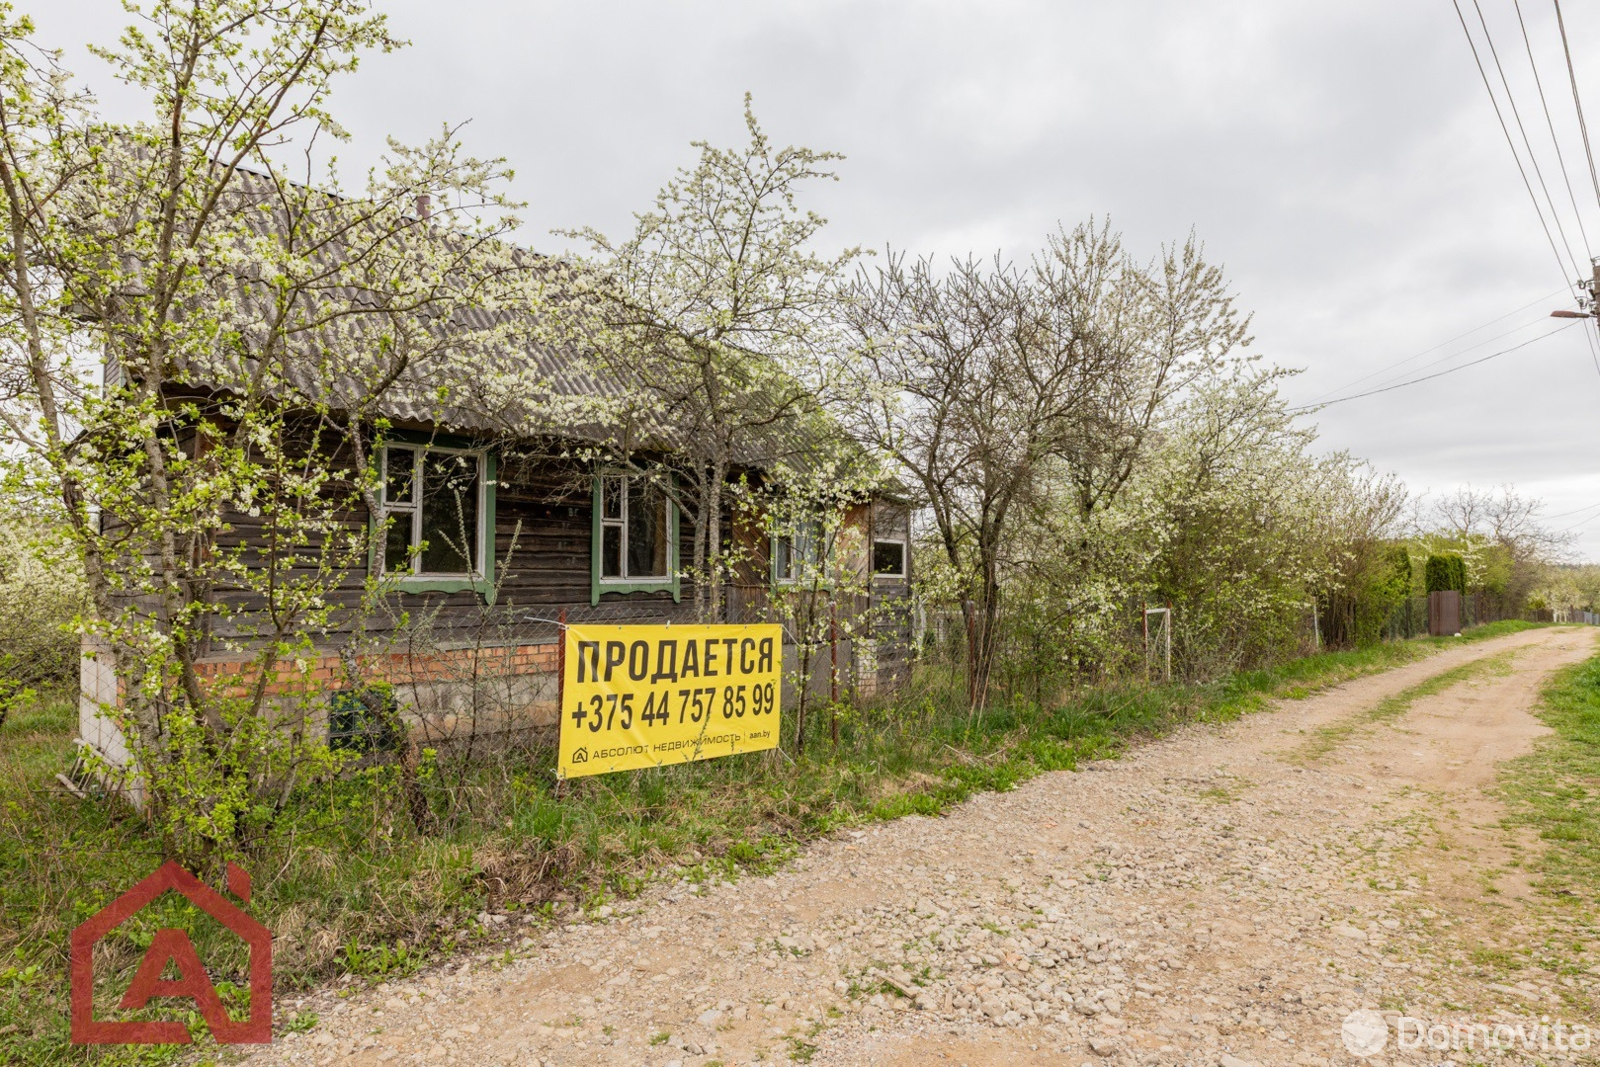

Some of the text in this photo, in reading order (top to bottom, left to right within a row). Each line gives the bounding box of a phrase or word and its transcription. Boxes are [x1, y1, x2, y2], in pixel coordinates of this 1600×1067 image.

[576, 637, 774, 685] ПРОДАЕТСЯ
[571, 682, 774, 733] +375 44 757 85 99
[592, 734, 741, 759] АБСОЛЮТ НЕДВИЖИМОСТЬ
[749, 730, 771, 739] aan.by
